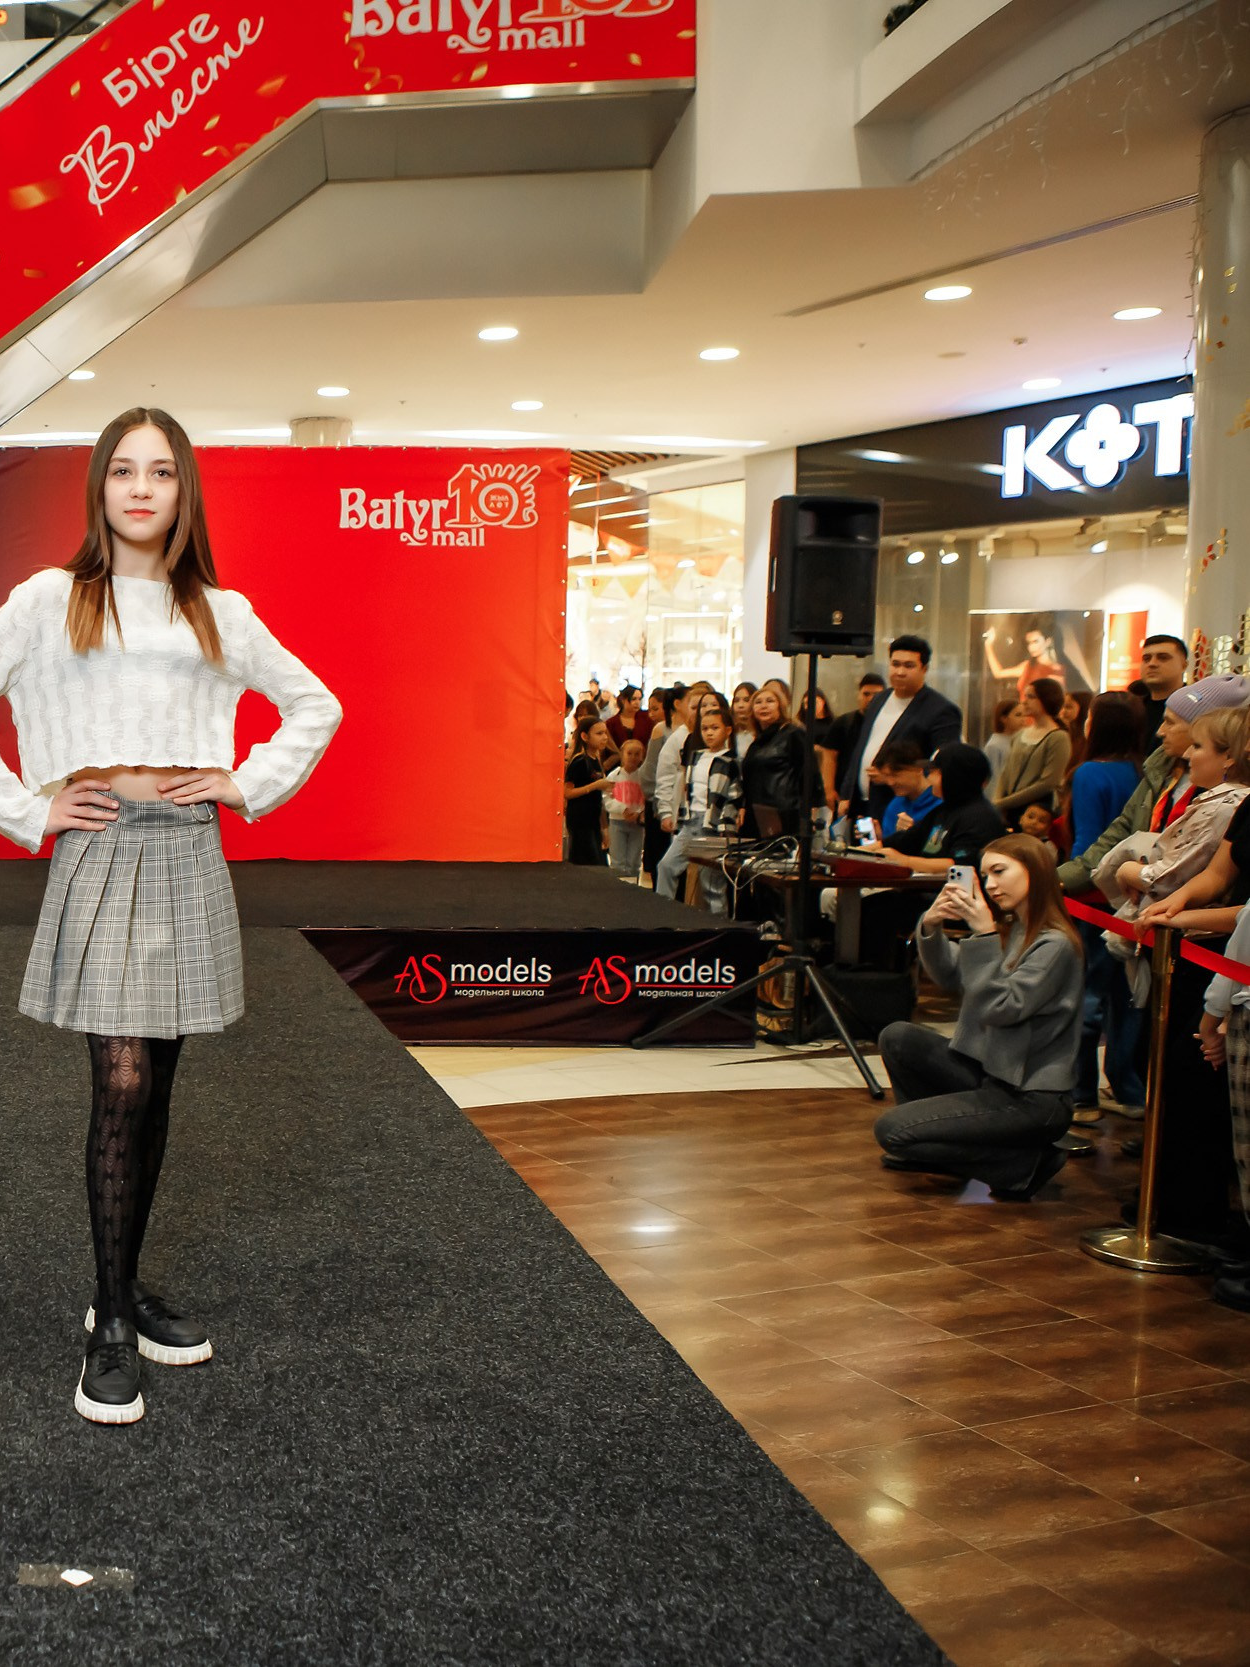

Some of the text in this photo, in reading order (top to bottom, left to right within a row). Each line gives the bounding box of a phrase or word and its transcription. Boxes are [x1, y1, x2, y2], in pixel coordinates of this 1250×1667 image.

[101, 13, 220, 108] Бірге
[498, 19, 586, 51] mall
[59, 16, 265, 217] Вместе
[1000, 393, 1193, 498] KOT
[338, 487, 449, 546] Batyr
[432, 527, 485, 546] mall
[393, 953, 552, 1004] AS models
[454, 989, 545, 997] модельная школа
[578, 955, 736, 1005] AS models
